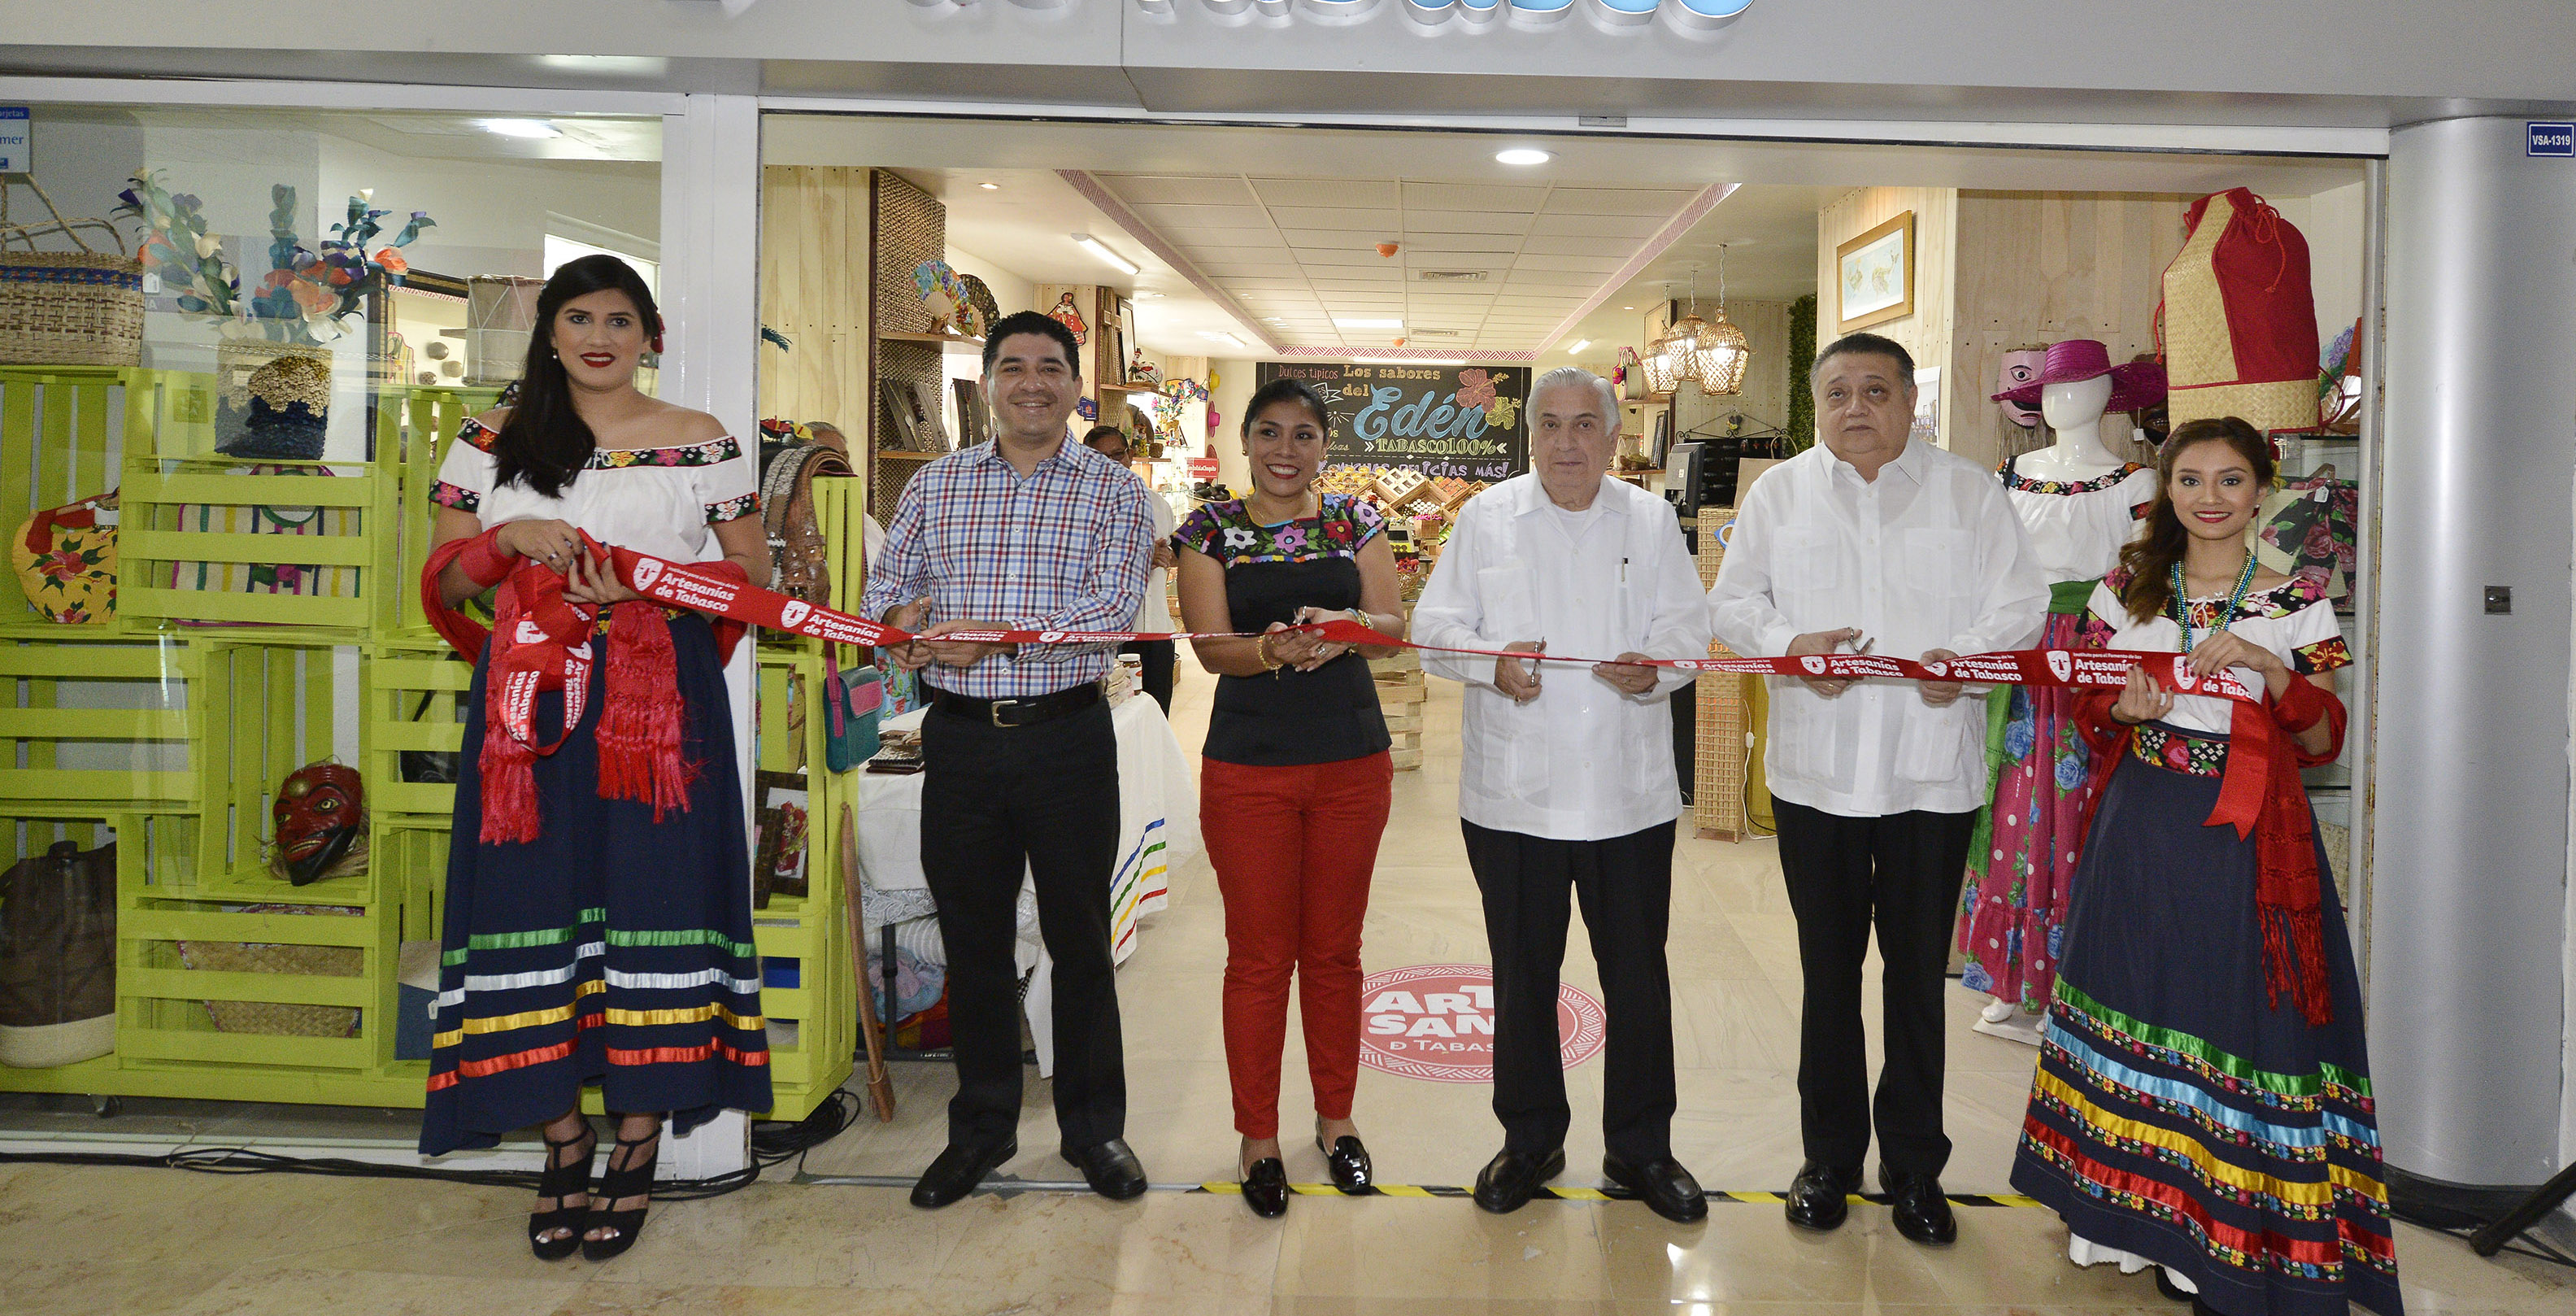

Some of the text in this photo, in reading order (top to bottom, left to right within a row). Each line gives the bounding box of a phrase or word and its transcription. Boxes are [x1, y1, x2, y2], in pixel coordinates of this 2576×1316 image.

[2532, 135, 2571, 146] VSA-1319
[1279, 364, 1307, 378] Dulces
[1343, 364, 1441, 381] Los sabores
[1342, 384, 1369, 397] del
[1353, 383, 1490, 441] Edén
[1475, 462, 1510, 478] MÁS!
[660, 573, 735, 601] Artesanías
[655, 585, 729, 612] de Tabasco
[808, 614, 881, 638] Artesanías
[803, 624, 876, 646] de Tabasco
[1830, 660, 1899, 671] Artesanías
[1850, 666, 1904, 677] Tabasco
[1950, 660, 2018, 669] Artesanías
[2075, 659, 2133, 672] Artesaní
[1954, 668, 2022, 681] de Tabasco
[2077, 672, 2128, 685] de Tabas
[518, 670, 541, 723] Tabasco
[565, 659, 576, 729] de Tabasco
[2202, 679, 2255, 699] de Taba
[1364, 985, 1494, 1014] ART
[1367, 1014, 1495, 1038] SAN
[1413, 1039, 1494, 1052] TABA
